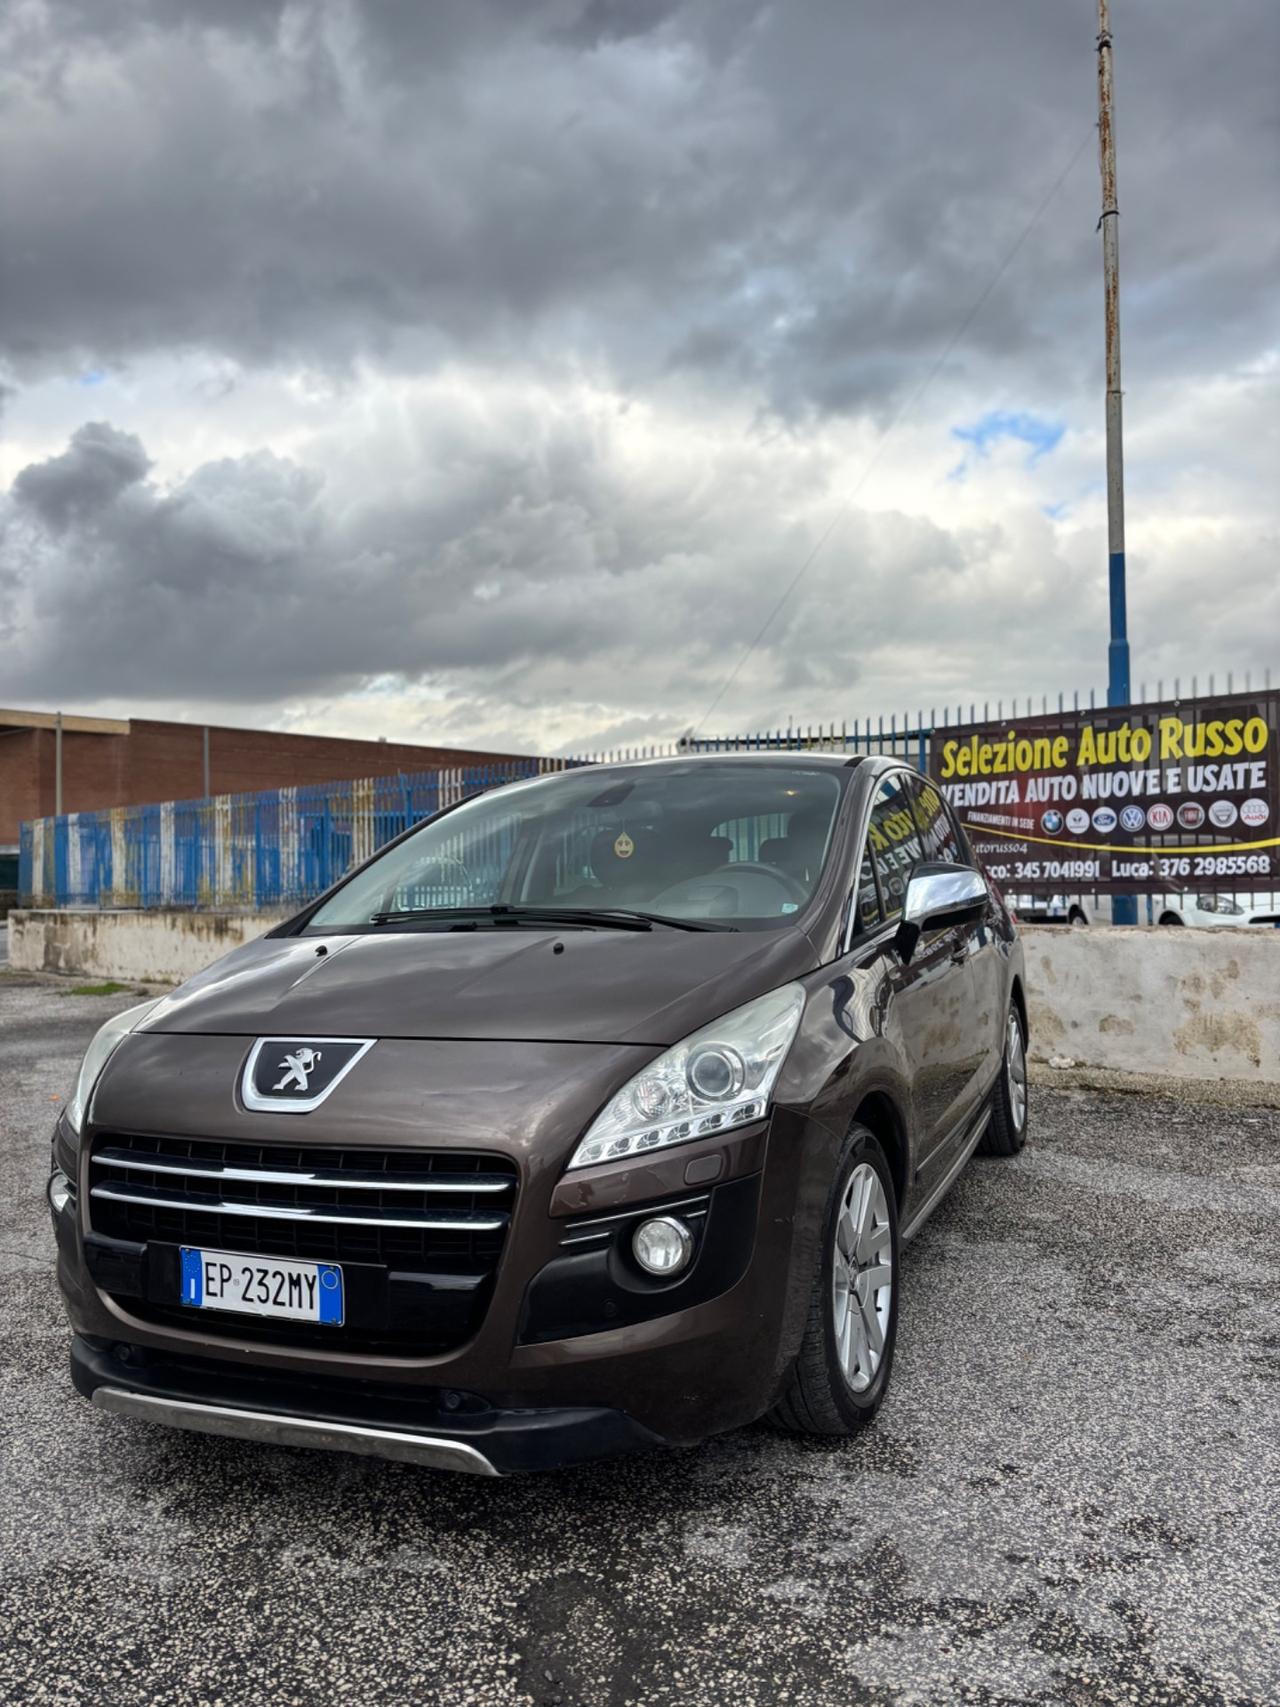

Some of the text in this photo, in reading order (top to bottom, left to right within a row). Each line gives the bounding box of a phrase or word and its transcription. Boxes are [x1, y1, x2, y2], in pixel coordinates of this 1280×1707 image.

[941, 730, 1069, 778] Selezione
[1076, 722, 1152, 766] Auto
[941, 761, 1266, 807] VENDITA AUTO NUOVE E USATE
[1151, 810, 1168, 824] KIA
[1014, 861, 1040, 879] 345
[1042, 860, 1100, 878] 7041991
[1111, 855, 1271, 878] Luca: 376 2985568
